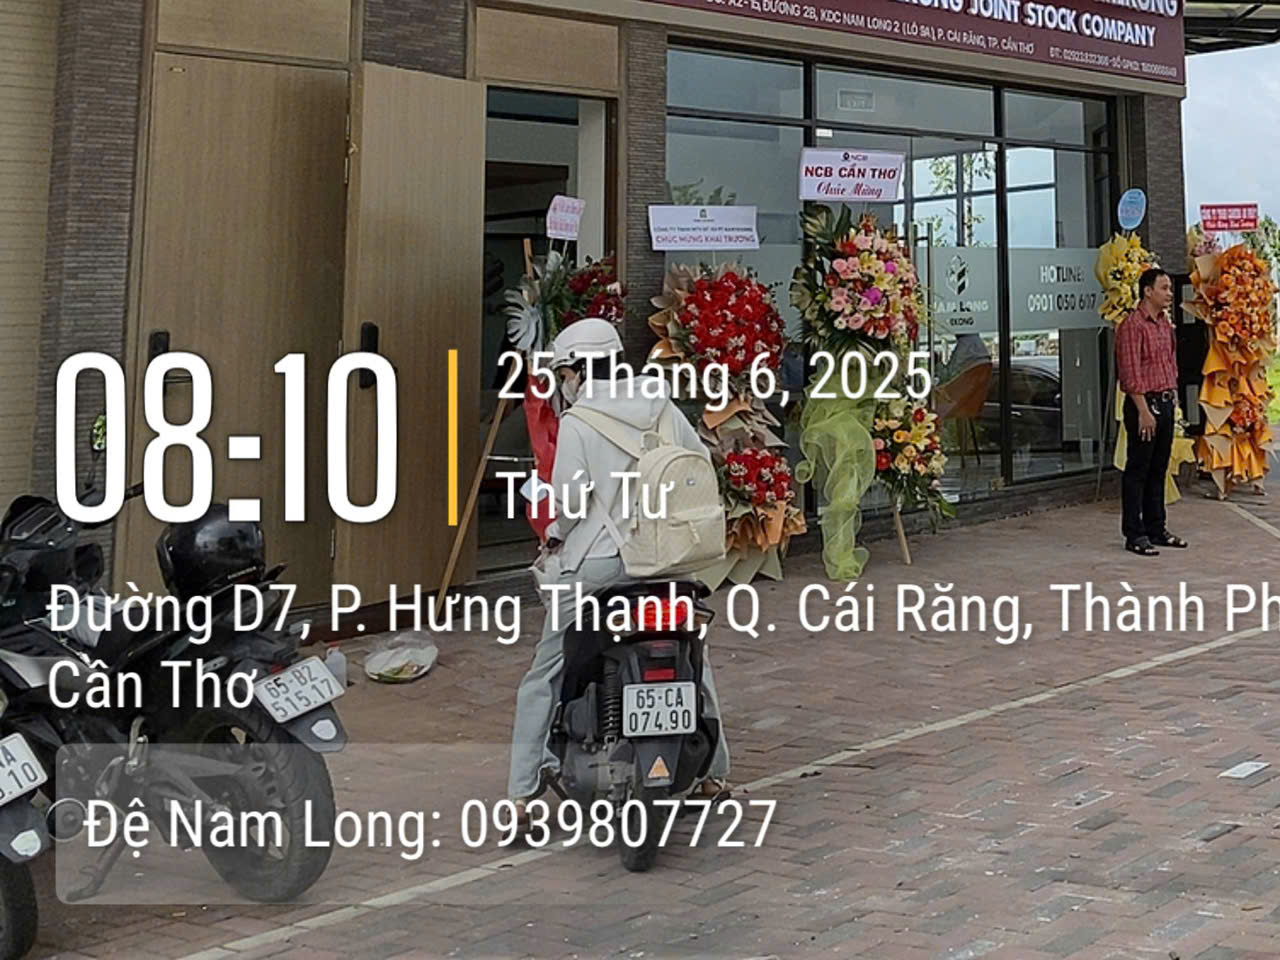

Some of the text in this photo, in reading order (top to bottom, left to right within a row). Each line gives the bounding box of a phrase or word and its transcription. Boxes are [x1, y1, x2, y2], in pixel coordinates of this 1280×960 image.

[1024, 2, 1079, 35] STOCK
[1081, 13, 1157, 49] COMPANY
[804, 166, 833, 178] NCB
[870, 167, 898, 180] THƠ
[271, 678, 337, 719] 515.17
[636, 686, 684, 709] 65-CA
[629, 709, 692, 732] 074.90
